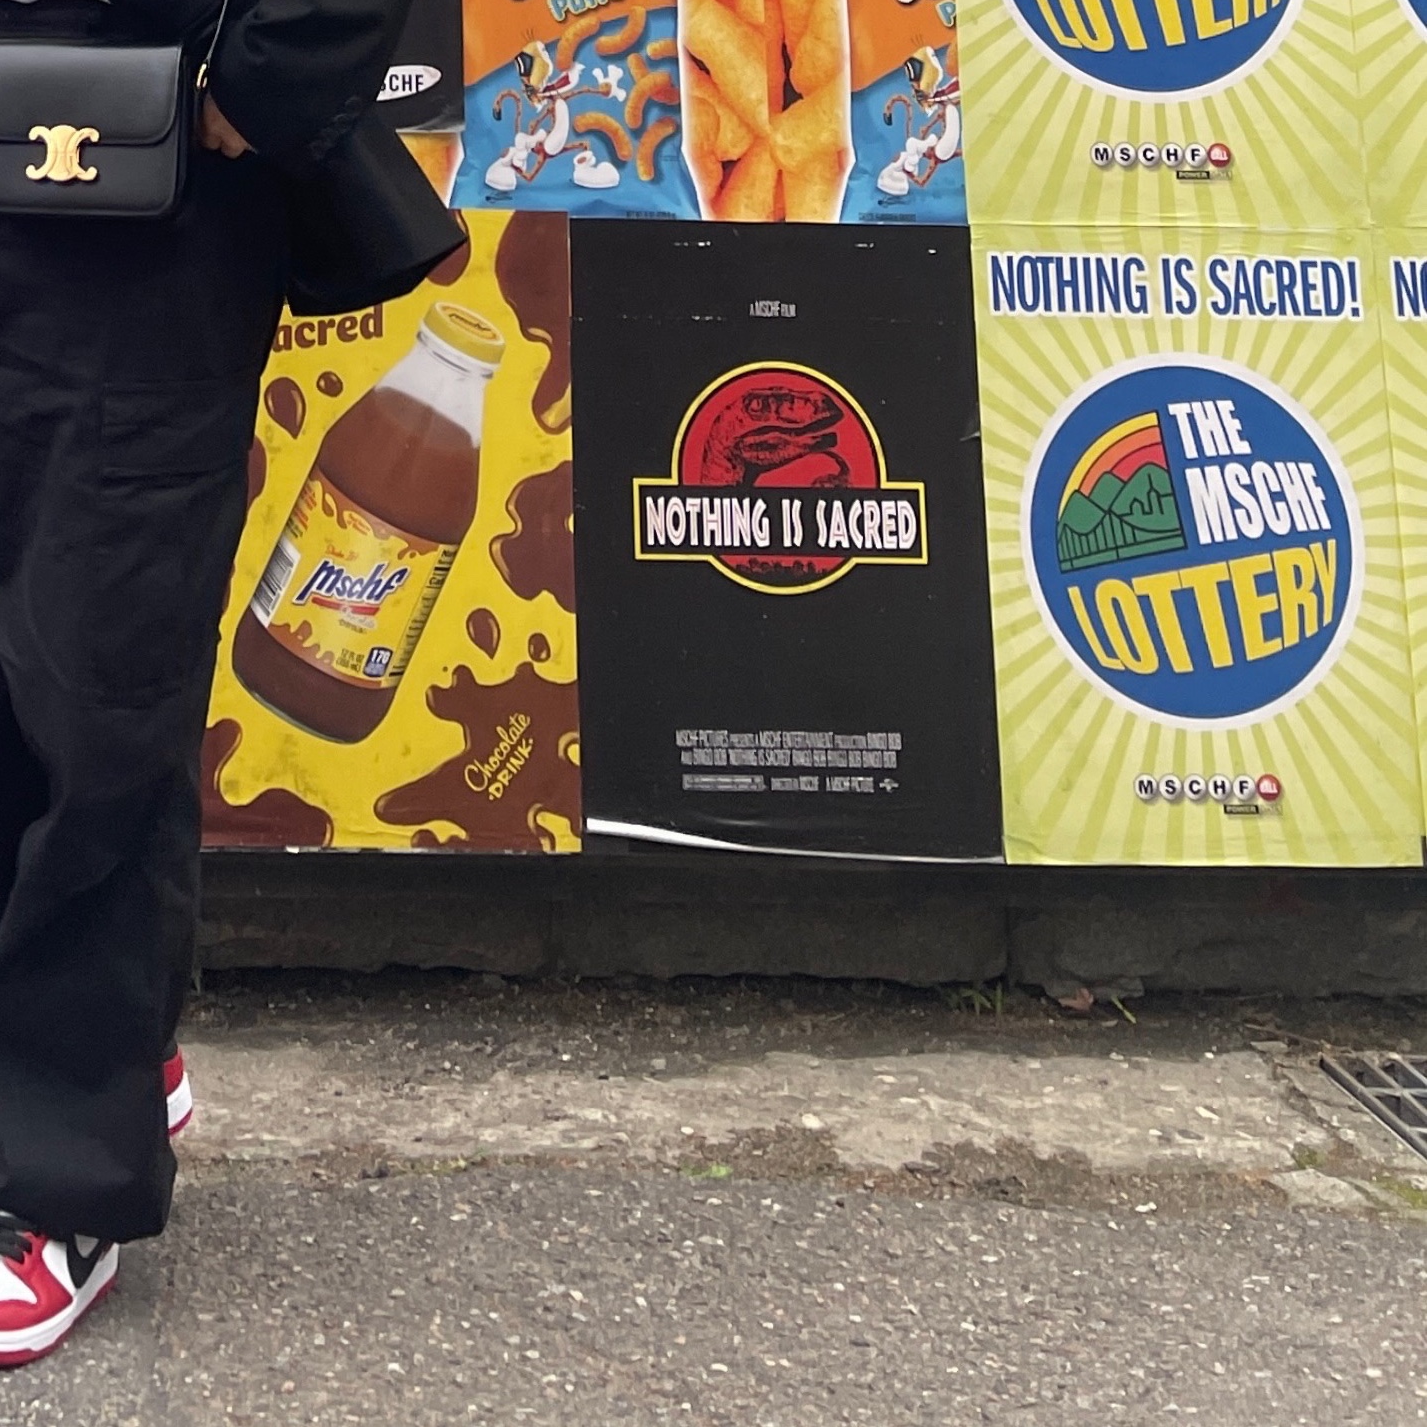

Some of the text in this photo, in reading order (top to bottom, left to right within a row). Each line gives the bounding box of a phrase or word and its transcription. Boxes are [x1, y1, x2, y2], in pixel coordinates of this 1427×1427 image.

[990, 254, 1148, 314] NOTHING
[1163, 256, 1197, 315] IS
[1210, 257, 1360, 318] SACRED!
[1168, 399, 1251, 460] THE
[645, 495, 918, 551] NOTHING IS SACRED
[1186, 460, 1332, 545] MSCHF
[293, 558, 410, 605] mschf
[1068, 539, 1338, 676] LOTTERY
[371, 649, 390, 665] 170
[464, 713, 531, 792] Chocolate
